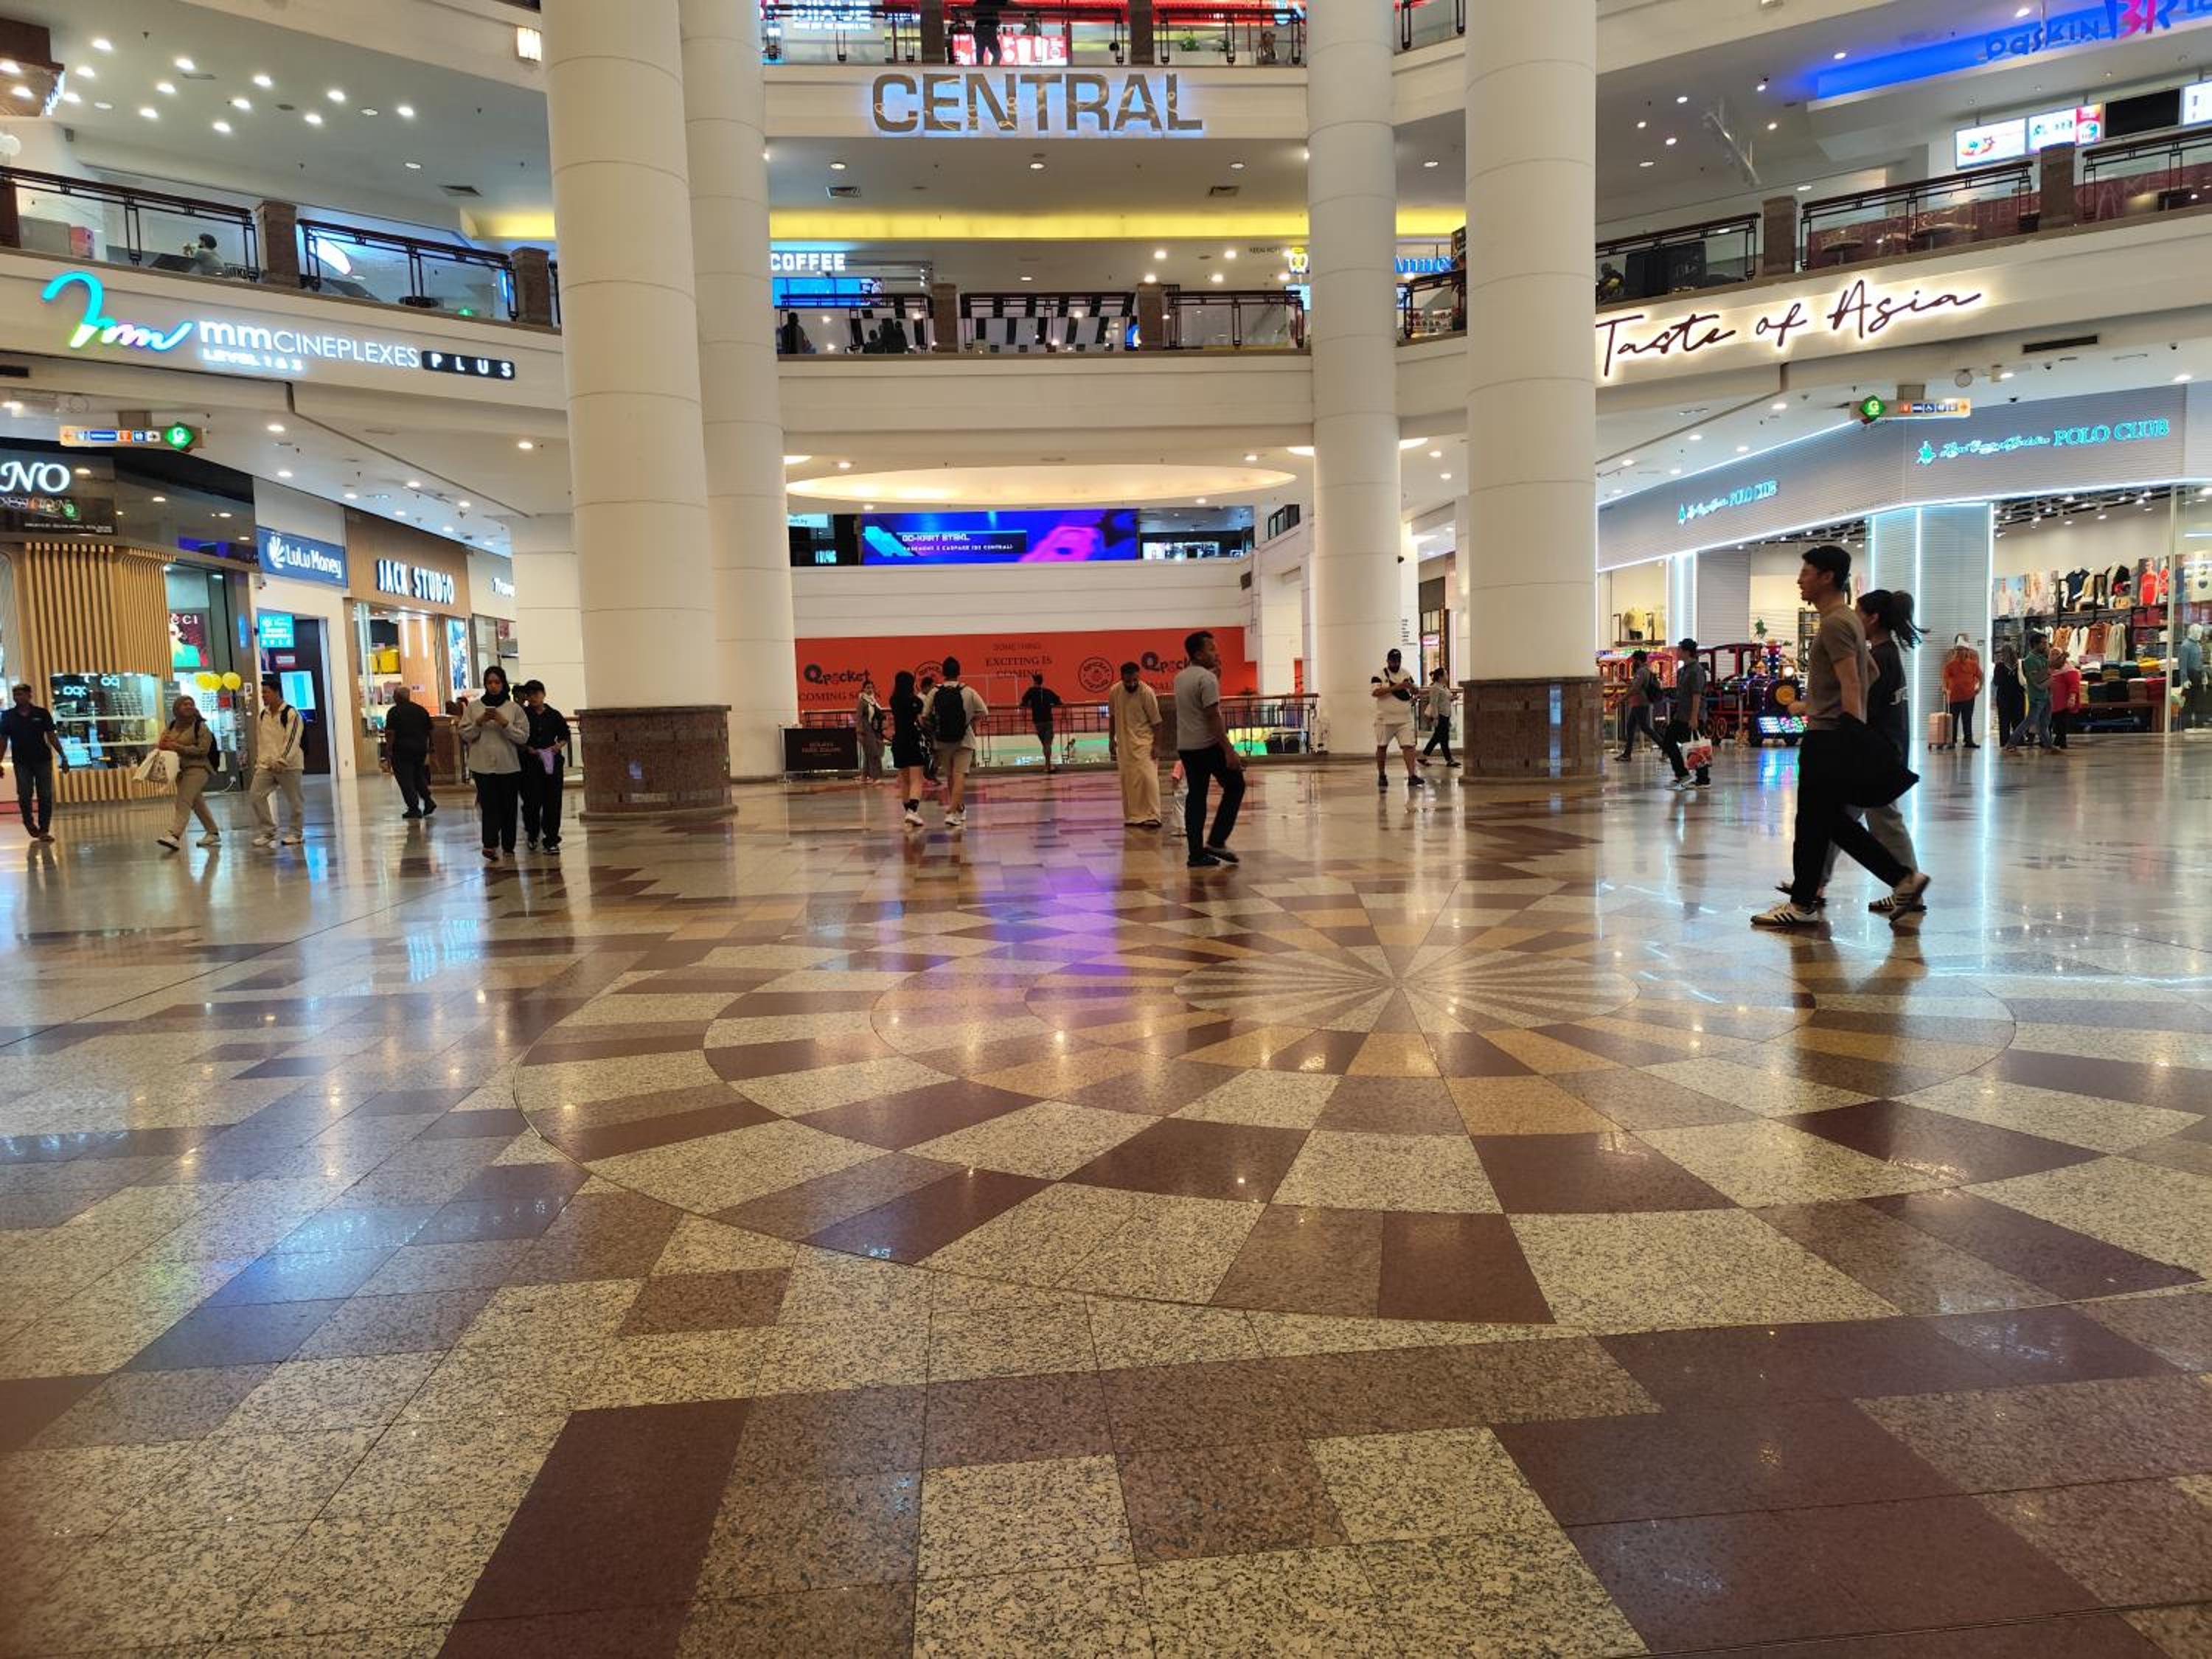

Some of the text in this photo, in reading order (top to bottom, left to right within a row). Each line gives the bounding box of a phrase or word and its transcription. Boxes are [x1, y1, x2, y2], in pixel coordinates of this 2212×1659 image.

[871, 72, 1203, 133] CENTRAL
[771, 253, 846, 271] COFFEE
[1595, 278, 1983, 378] Taste of Asia
[430, 352, 512, 378] PLUS
[2053, 425, 2111, 447] POLO
[2113, 417, 2170, 441] CLUB
[310, 549, 343, 580] Money
[377, 560, 408, 597] JACK
[986, 656, 1039, 667] EXCITING
